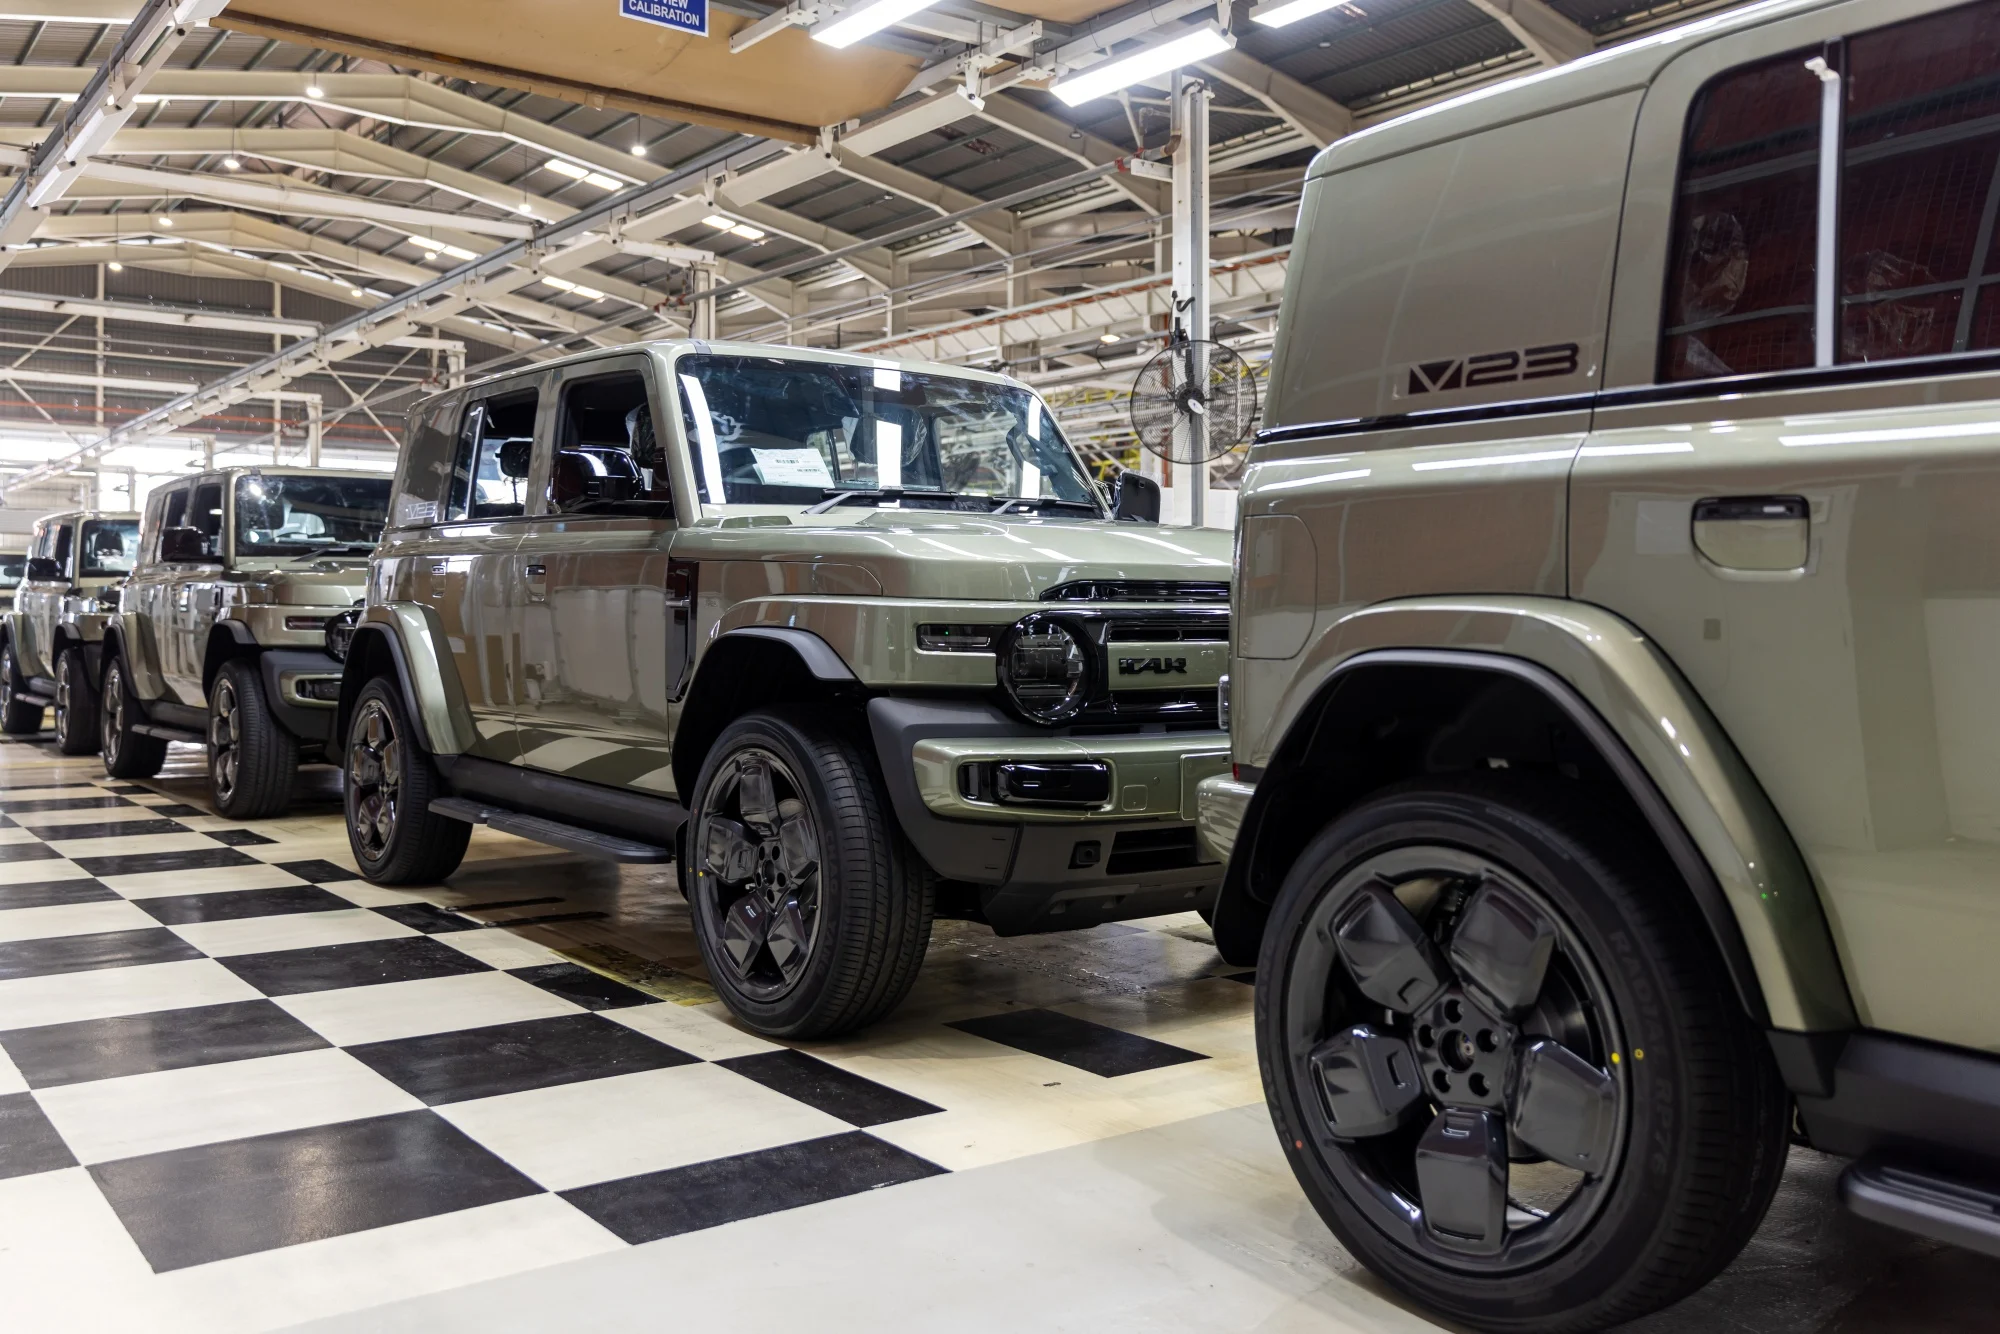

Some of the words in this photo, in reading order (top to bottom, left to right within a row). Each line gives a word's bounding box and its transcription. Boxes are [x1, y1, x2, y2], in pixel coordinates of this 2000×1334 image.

[628, 0, 699, 26] CALIBRATION
[1408, 342, 1580, 395] V23
[1608, 931, 1669, 1060] RADIAL
